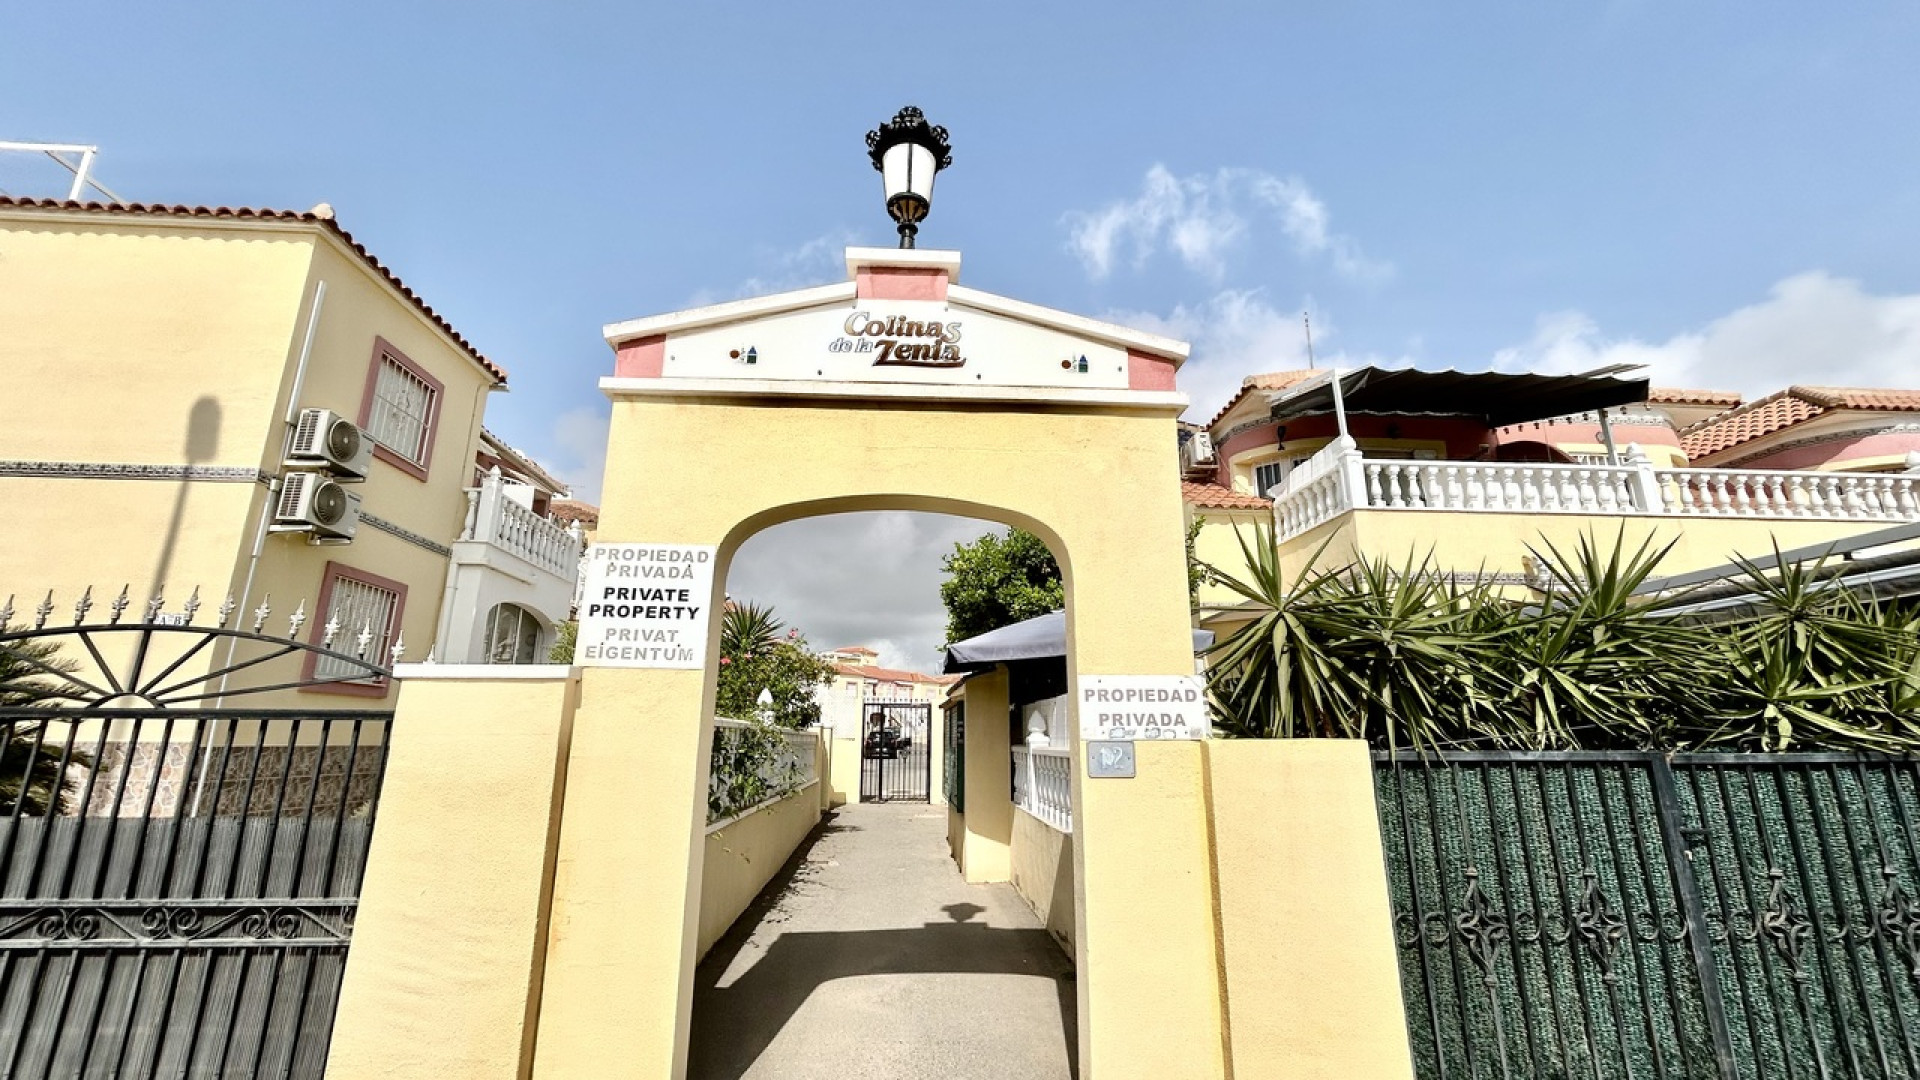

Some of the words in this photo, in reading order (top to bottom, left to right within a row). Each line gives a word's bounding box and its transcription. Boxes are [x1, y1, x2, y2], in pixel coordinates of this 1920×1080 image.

[844, 311, 962, 343] Colinas
[872, 339, 965, 367] Zenia
[595, 548, 709, 563] PROPIEDAD
[605, 565, 694, 579] PRIVADA
[603, 587, 690, 602] PRIVATE
[589, 604, 699, 620] PROPERTY
[605, 628, 679, 642] PRIVAT
[585, 645, 693, 661] EIGENTUM
[1084, 689, 1198, 702] PROPIEDAD
[1098, 713, 1186, 727] PRIVADA
